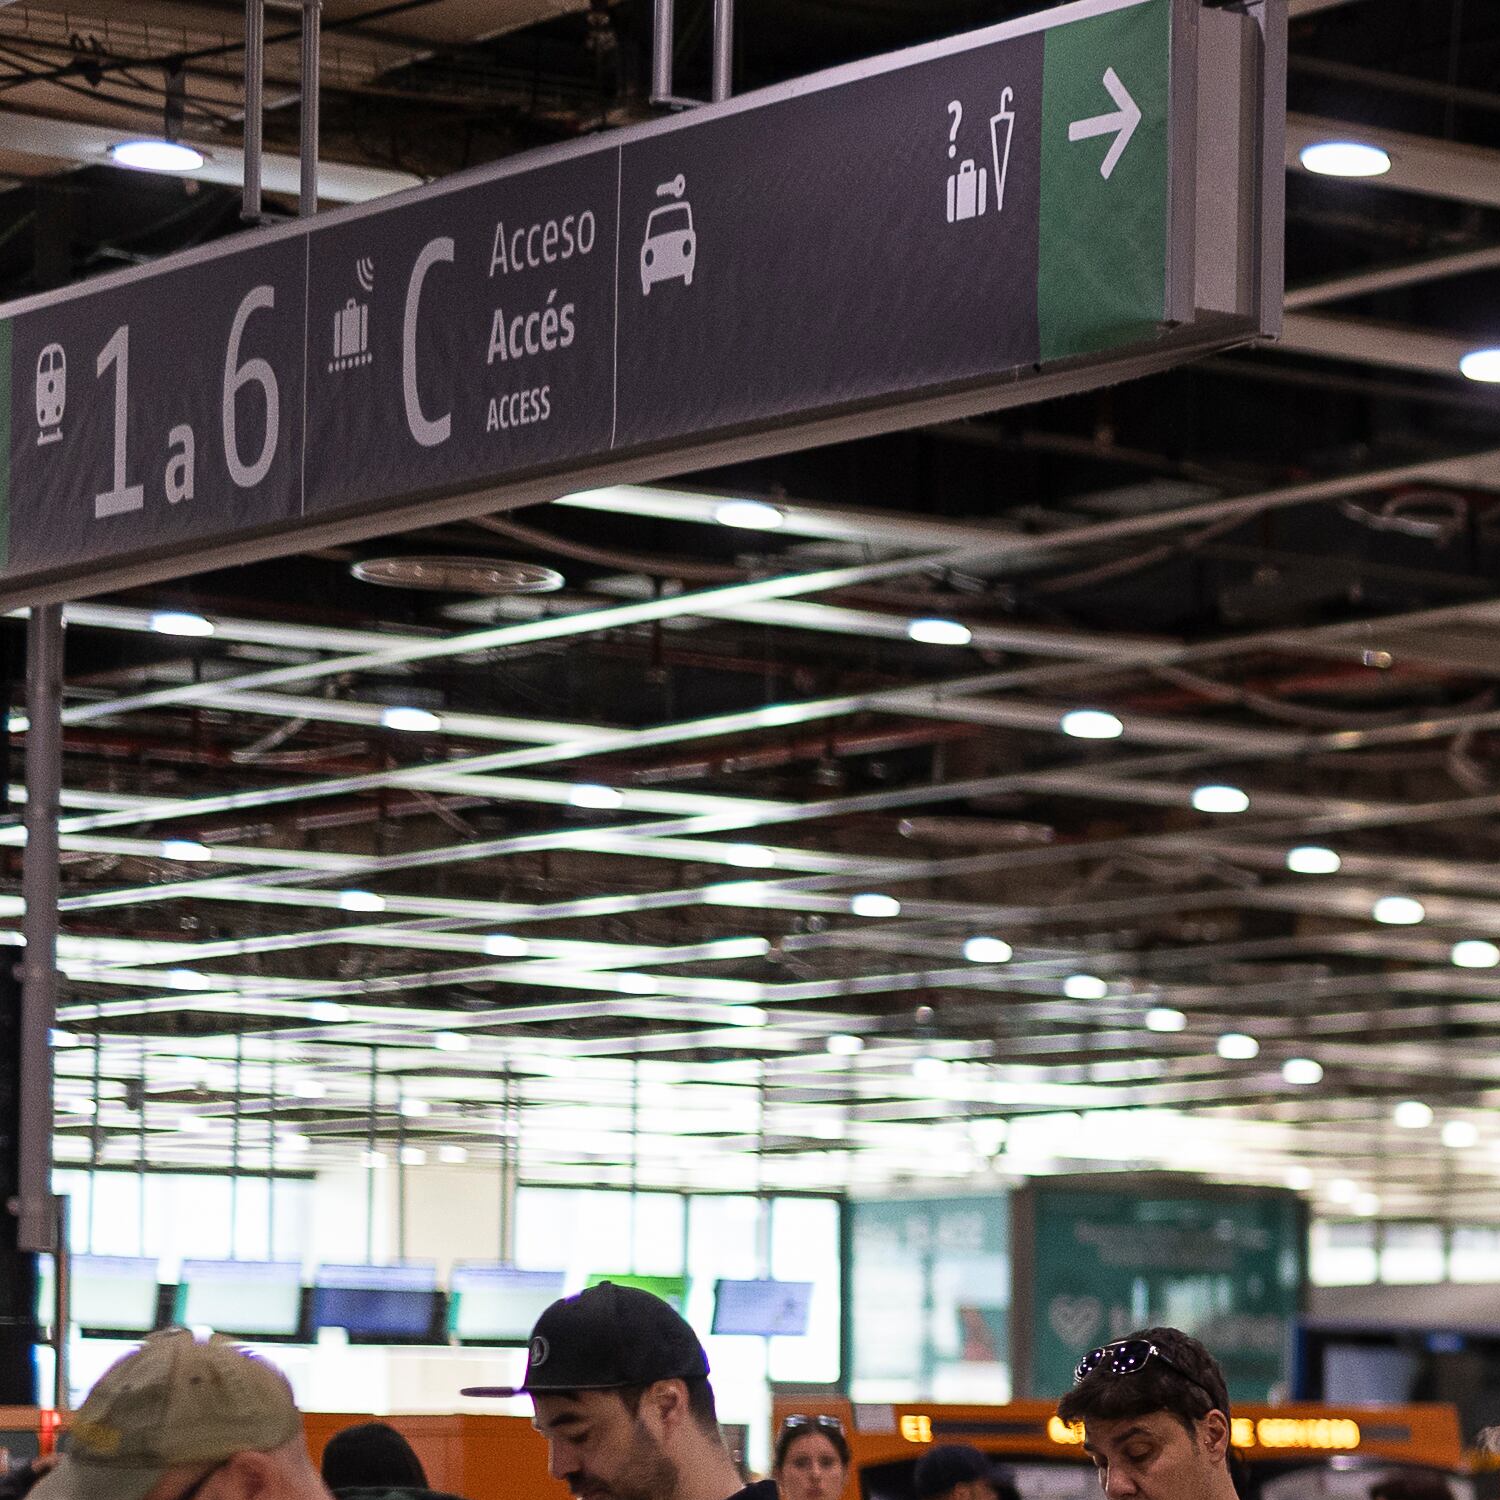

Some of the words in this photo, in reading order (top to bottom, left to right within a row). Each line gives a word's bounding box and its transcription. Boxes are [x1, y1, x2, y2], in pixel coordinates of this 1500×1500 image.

[489, 209, 596, 278] Acceso
[402, 236, 455, 448] C
[487, 288, 575, 365] Accés
[95, 323, 144, 520] 1
[165, 424, 196, 504] a
[222, 284, 280, 489] 6
[486, 385, 551, 433] ACCESS
